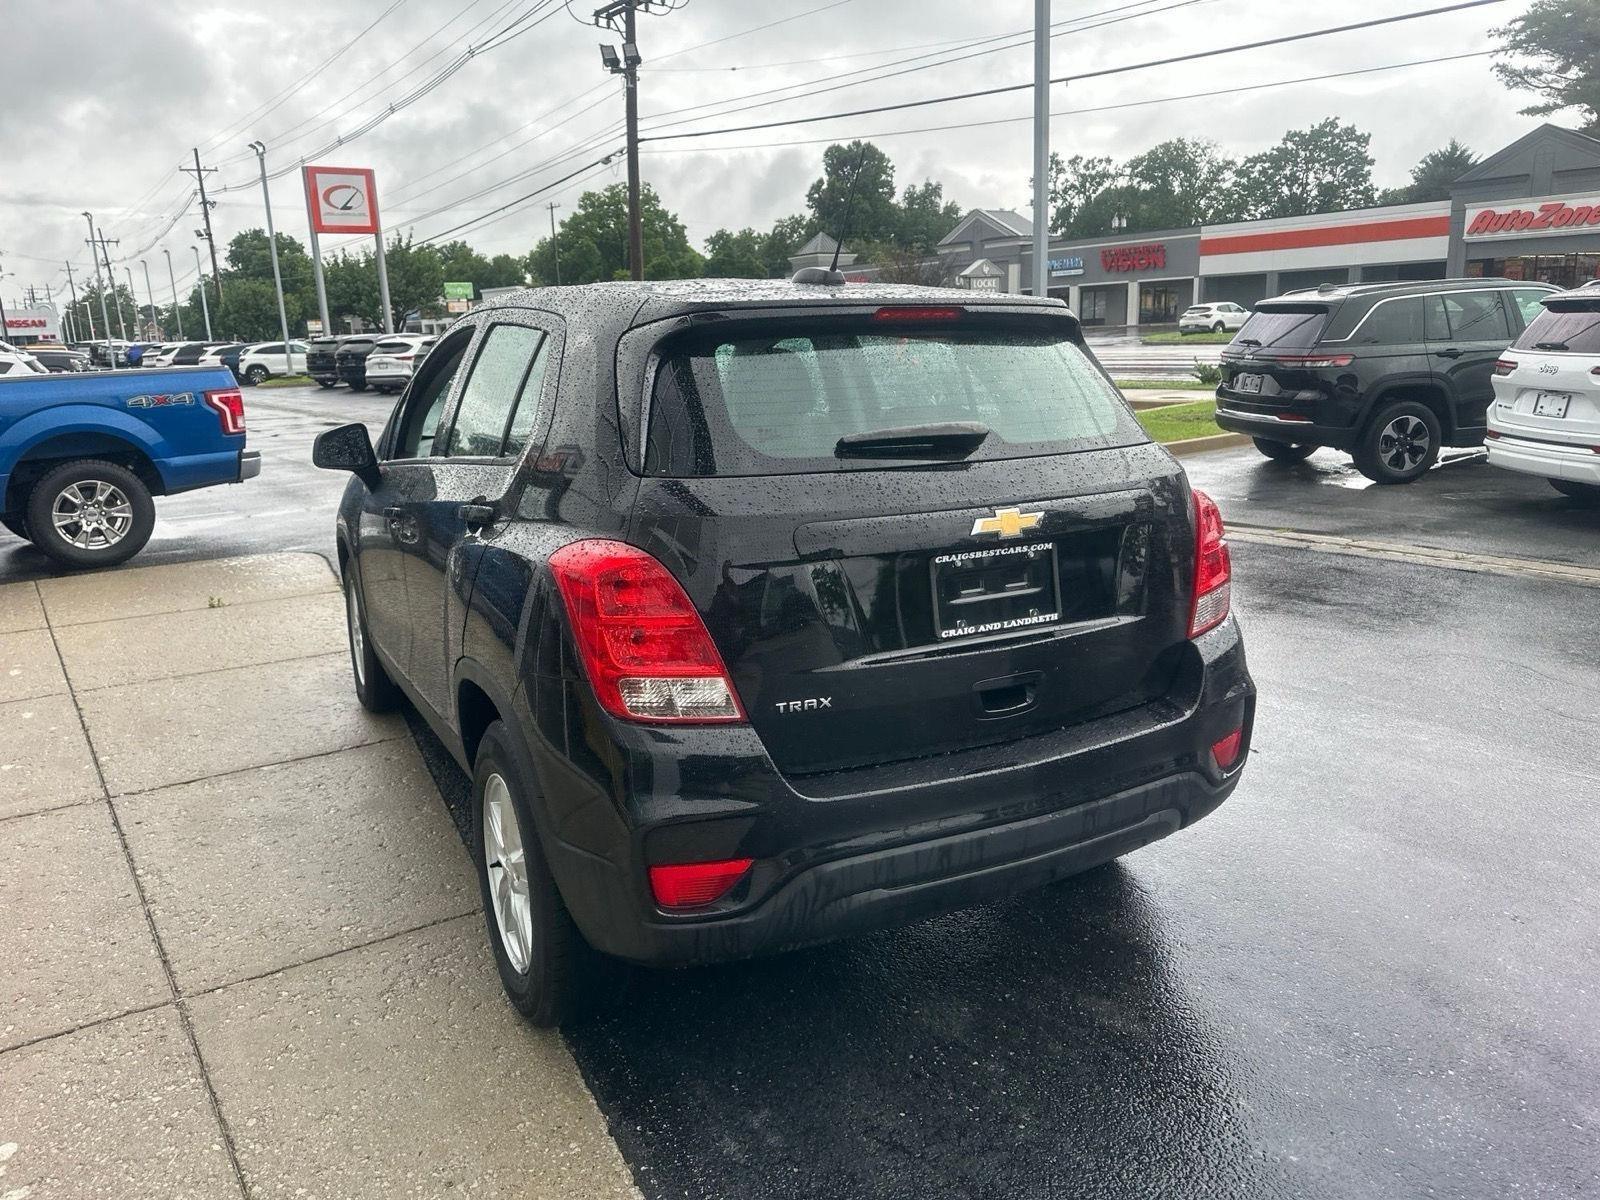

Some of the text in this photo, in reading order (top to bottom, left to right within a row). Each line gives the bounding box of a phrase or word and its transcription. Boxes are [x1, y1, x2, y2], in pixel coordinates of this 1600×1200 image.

[1102, 252, 1166, 273] VISION
[973, 279, 997, 289] LOCKE
[5, 319, 47, 328] NISSAN
[1539, 363, 1559, 375] Jeep
[934, 542, 1053, 564] CRAIGSBESTCARS.COM
[941, 613, 1059, 638] CRAIG AND LANDRETH
[775, 696, 832, 714] TRAX
